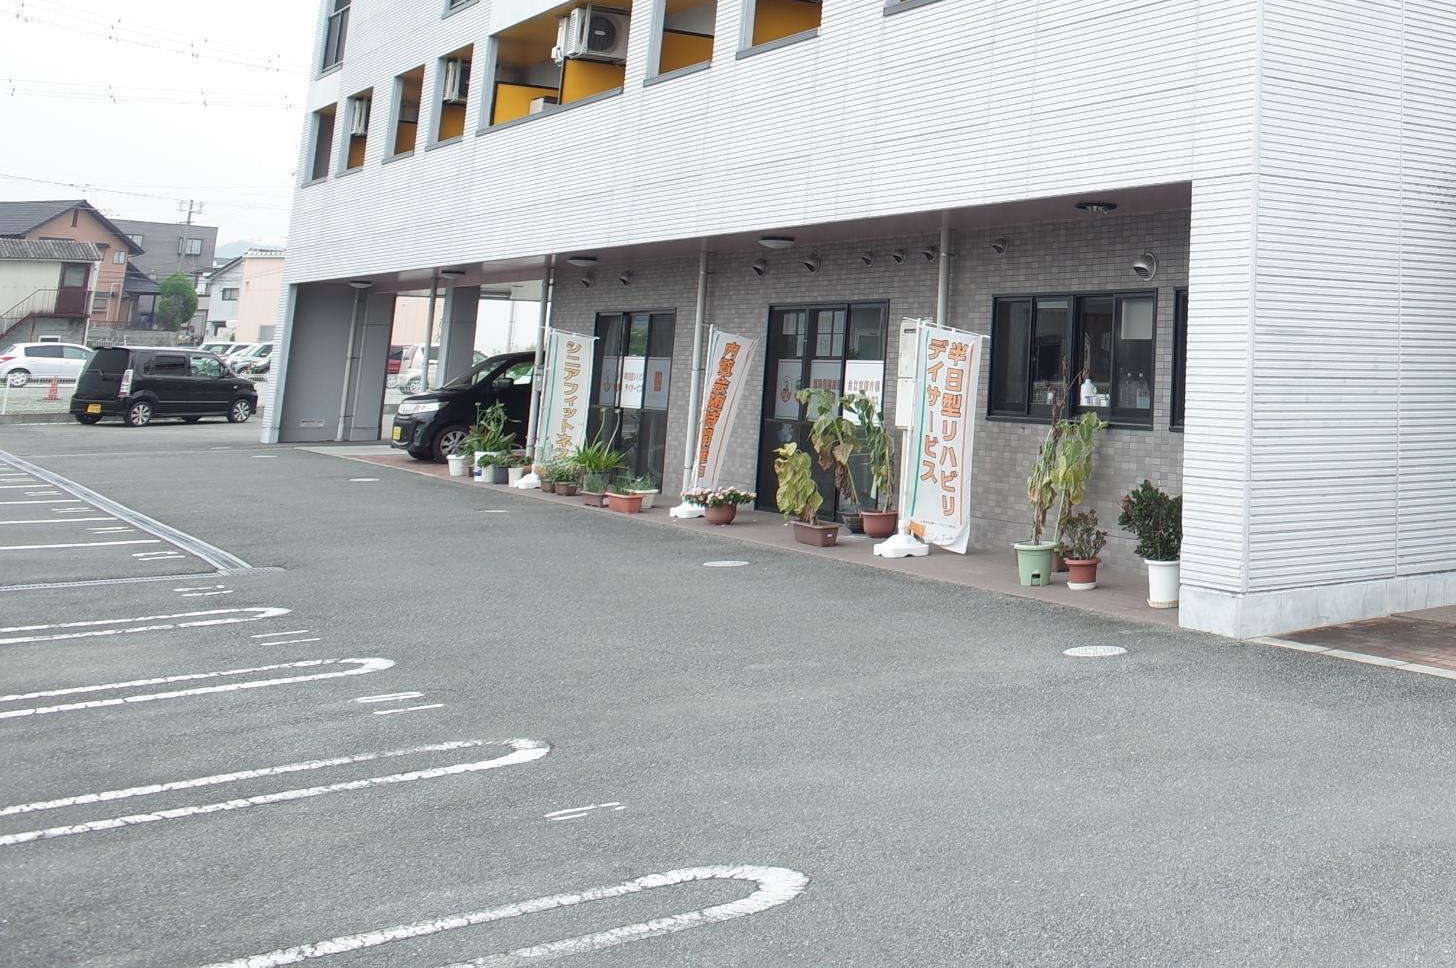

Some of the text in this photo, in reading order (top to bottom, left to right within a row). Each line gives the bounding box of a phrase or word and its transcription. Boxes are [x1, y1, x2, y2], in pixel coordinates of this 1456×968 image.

[920, 338, 949, 484] デイサービス
[940, 342, 969, 516] 半日型リハビリ
